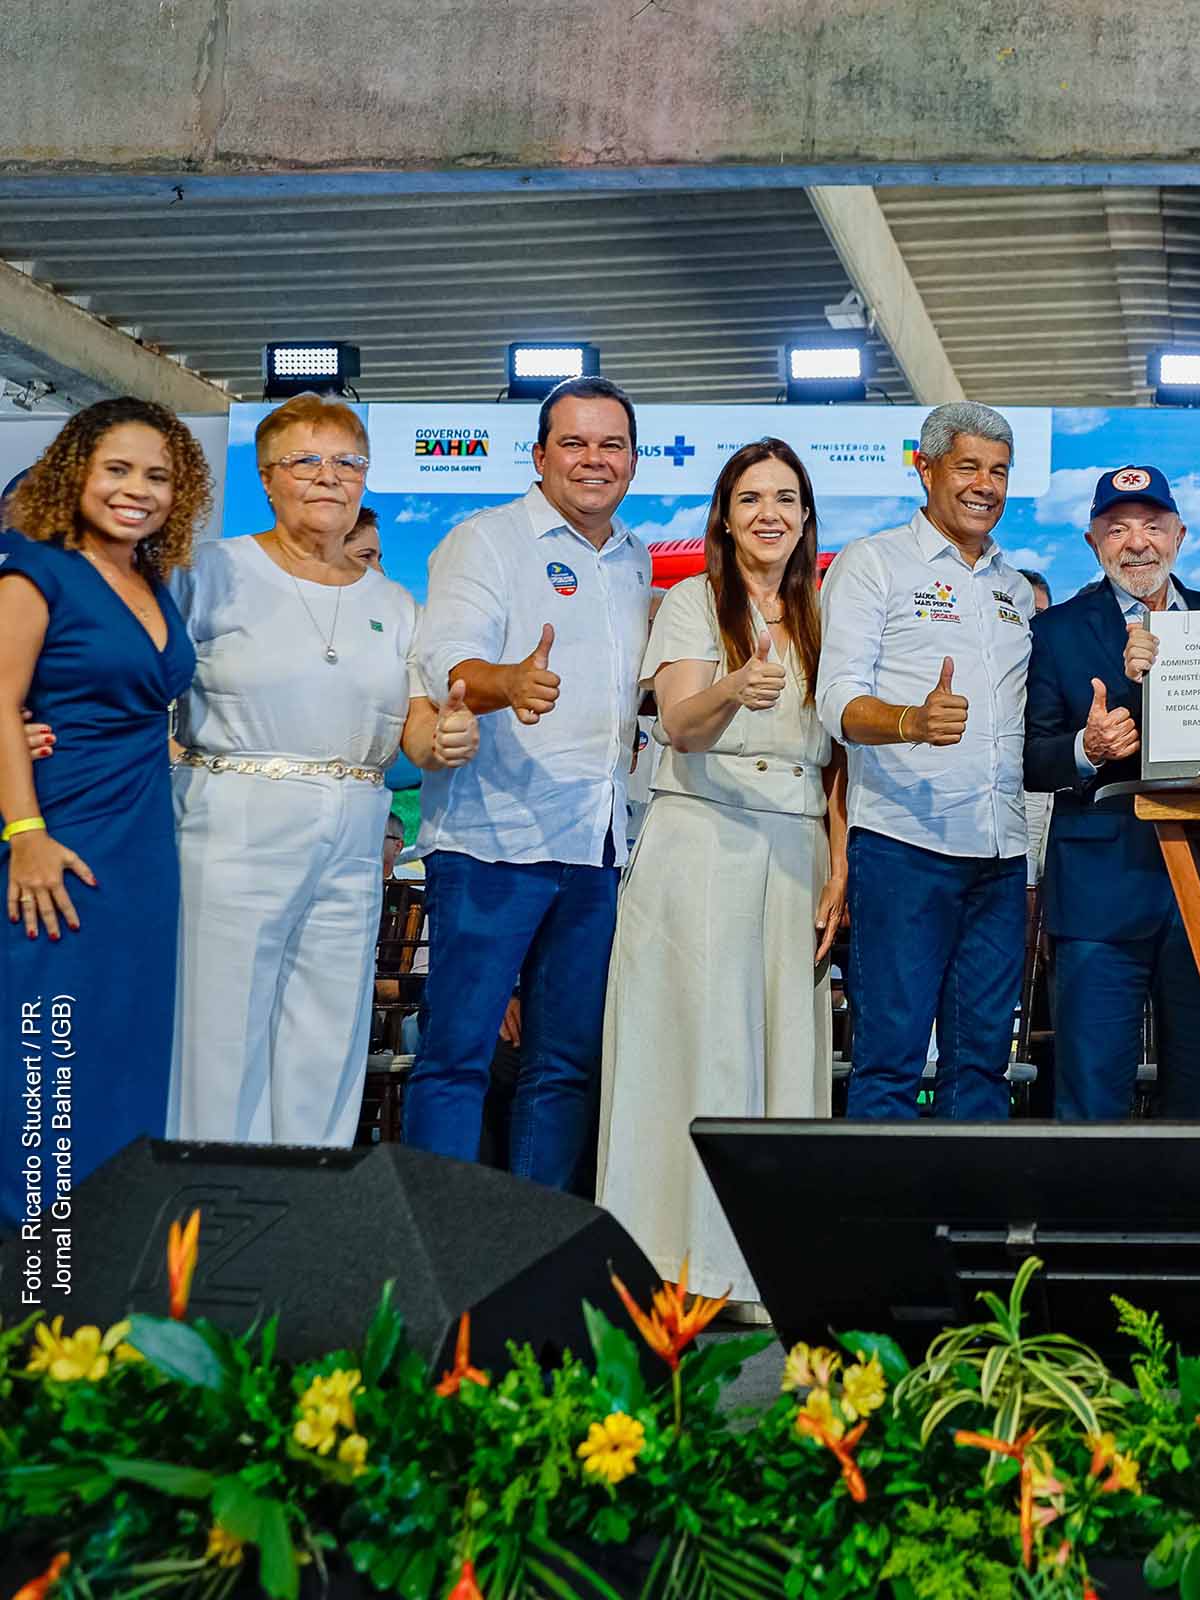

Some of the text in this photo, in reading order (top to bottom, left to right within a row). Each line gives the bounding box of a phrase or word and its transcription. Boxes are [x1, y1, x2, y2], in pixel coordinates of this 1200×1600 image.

[416, 429, 489, 439] GOVERNO DA
[415, 439, 489, 456] BAHIA
[637, 445, 661, 457] SUS
[811, 442, 869, 451] MINISTÉRIO
[1165, 704, 1199, 712] MEDICAL
